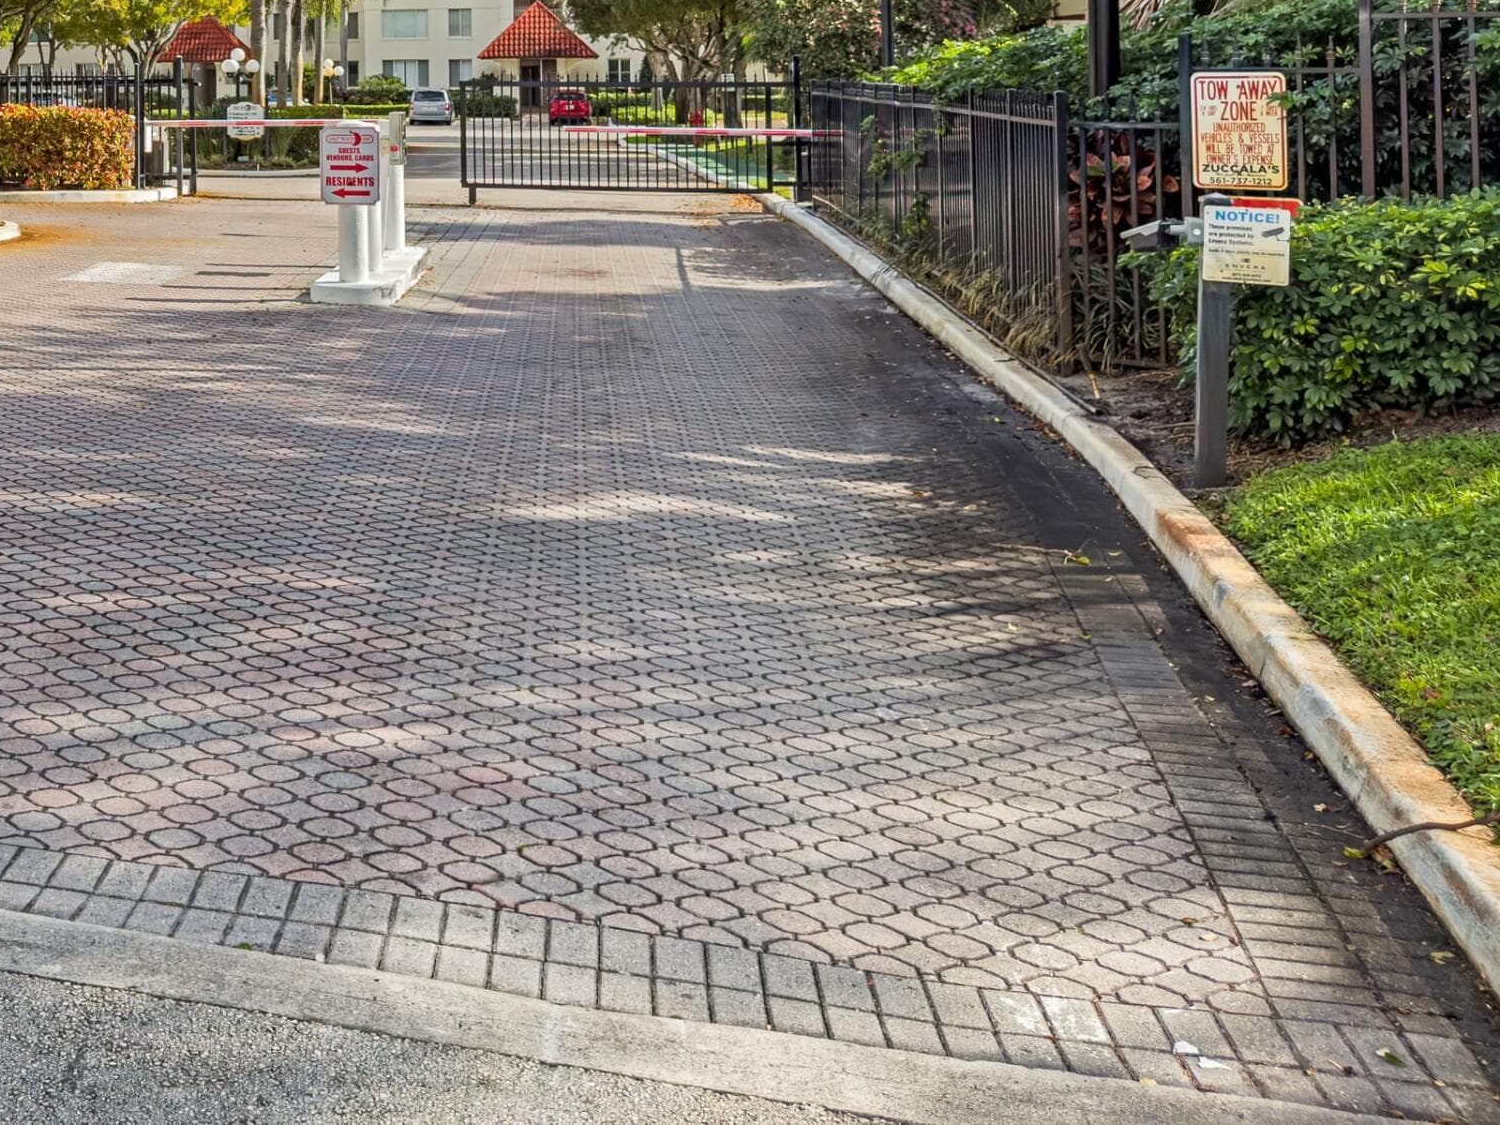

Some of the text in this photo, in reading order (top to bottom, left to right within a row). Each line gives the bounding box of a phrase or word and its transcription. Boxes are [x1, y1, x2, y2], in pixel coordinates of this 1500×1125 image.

[1198, 80, 1277, 100] TOW AWAY
[1220, 101, 1258, 121] ZONE
[1213, 122, 1266, 132] UNAUTHORIZED
[1201, 133, 1280, 144] VEHICLES & VESSELS
[1205, 144, 1275, 155] WILL BE TOWED AT
[1242, 155, 1274, 165] EXPENSE
[1202, 164, 1280, 174] ZUCCALA'S
[326, 176, 374, 186] RESIDENTS
[1209, 176, 1272, 185] 561-737-1212
[1215, 210, 1280, 224] NOTICE!
